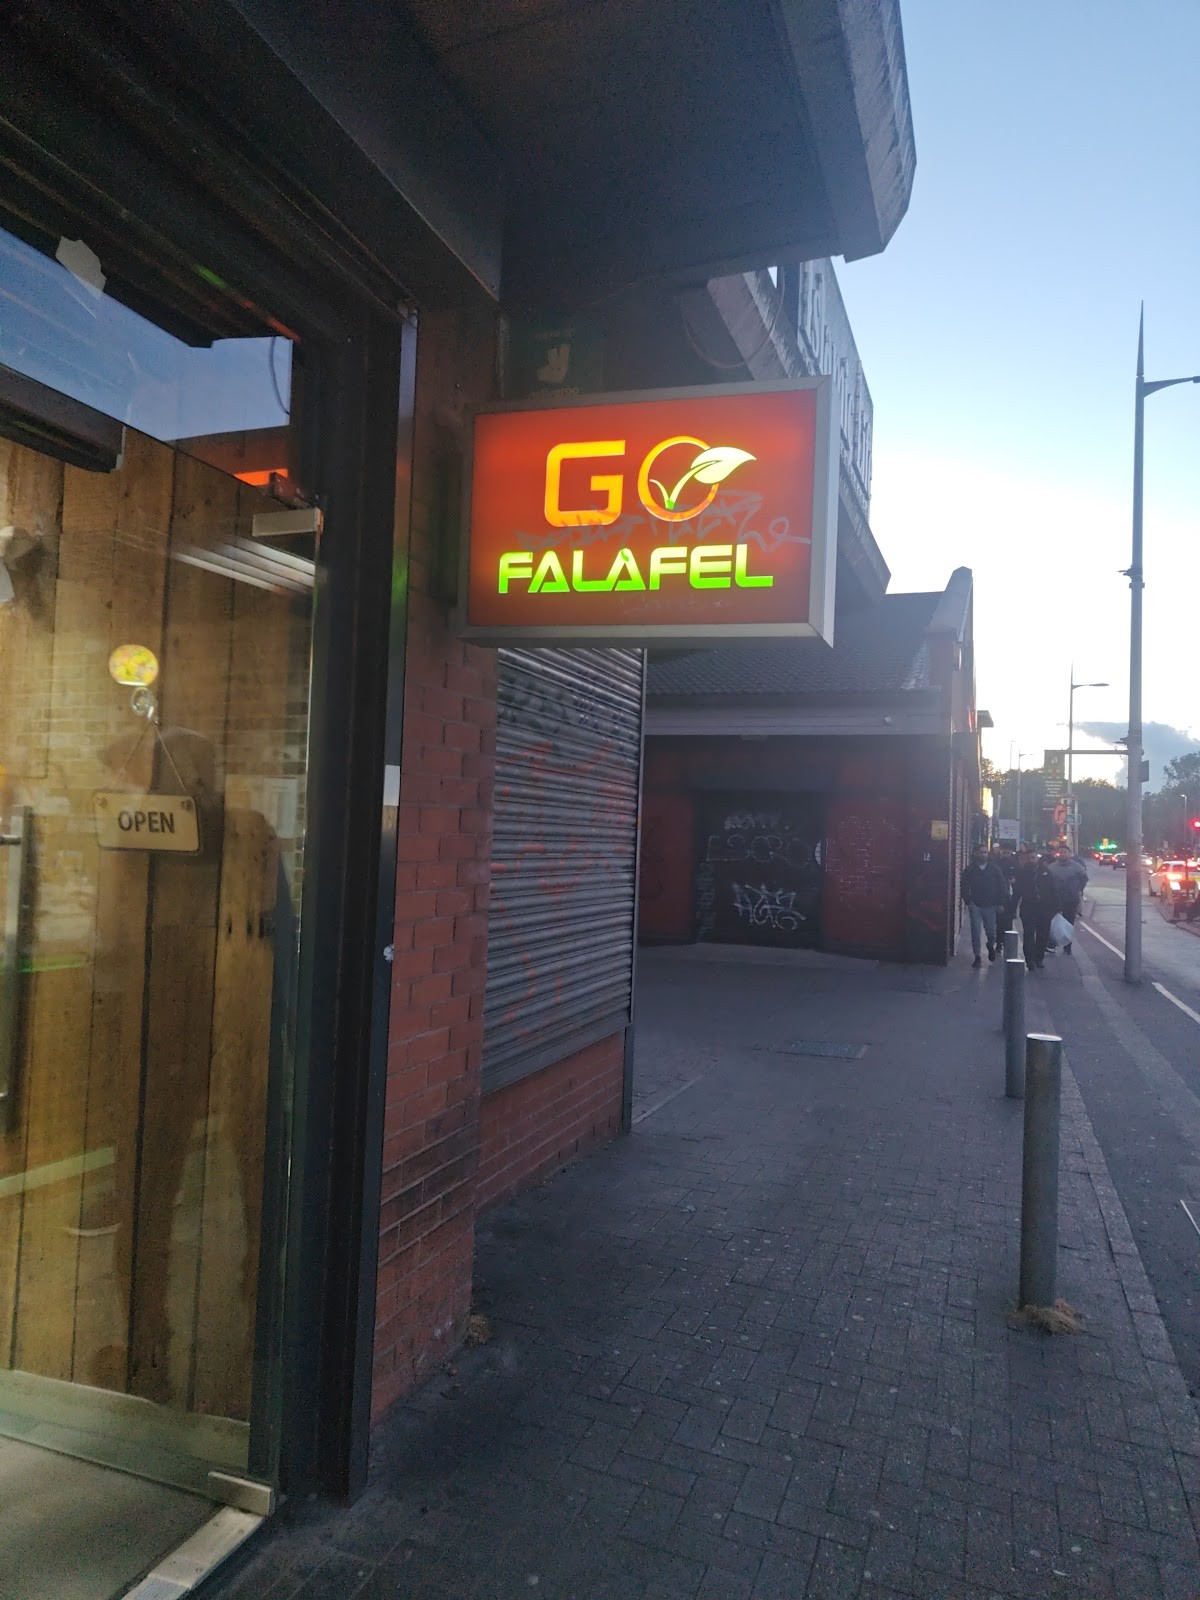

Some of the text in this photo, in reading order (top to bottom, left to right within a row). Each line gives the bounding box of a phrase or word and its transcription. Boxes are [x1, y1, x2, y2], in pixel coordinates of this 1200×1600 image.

[544, 435, 719, 528] GO
[498, 544, 774, 594] FALAFEL
[118, 810, 175, 834] OPEN
